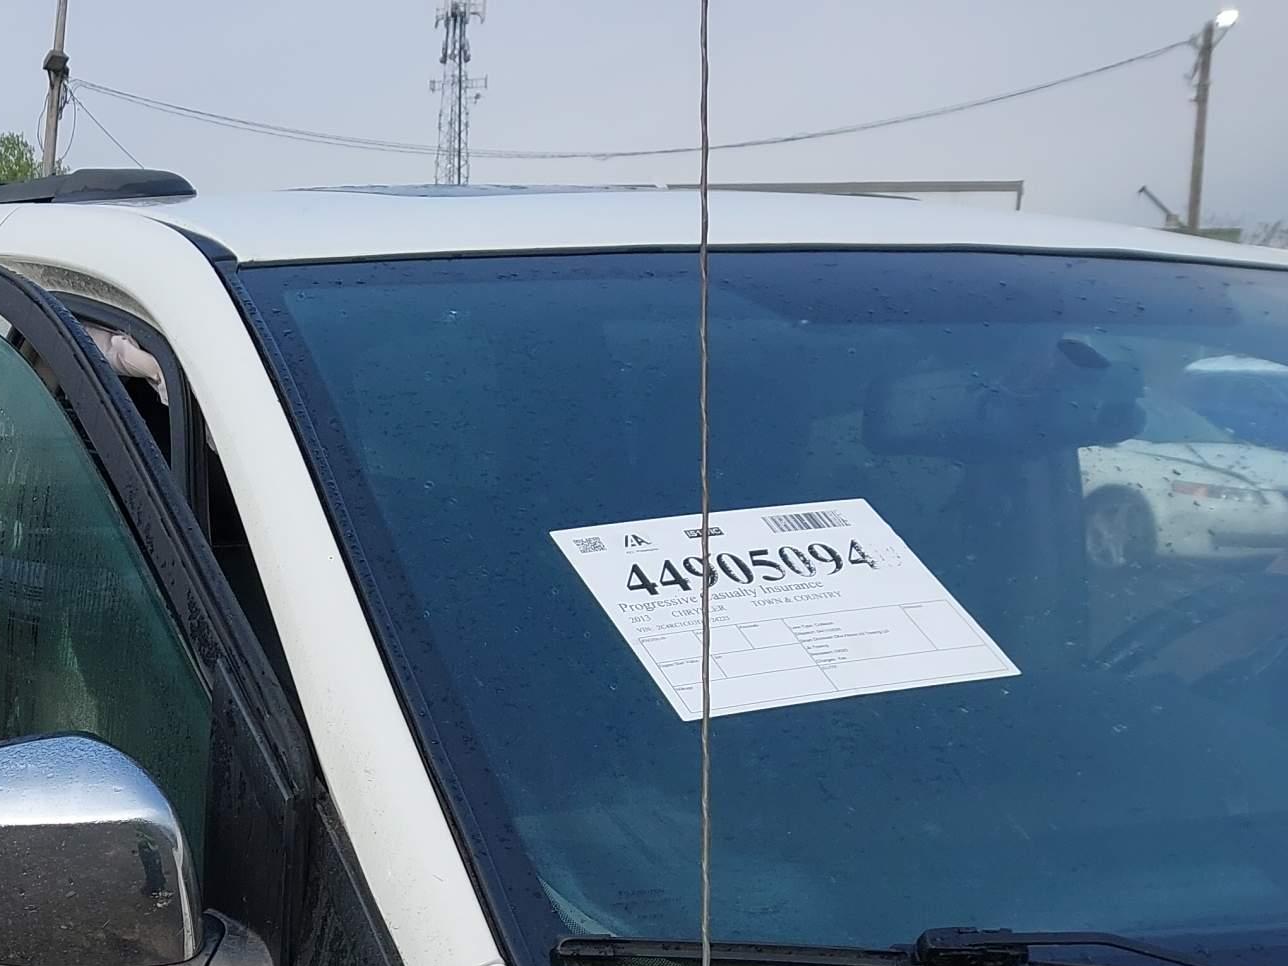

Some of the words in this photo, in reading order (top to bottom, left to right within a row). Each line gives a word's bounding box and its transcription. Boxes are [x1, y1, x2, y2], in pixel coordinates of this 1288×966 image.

[626, 539, 880, 596] 44905094
[618, 594, 698, 613] Progressive
[700, 585, 758, 602] asualty
[761, 580, 824, 596] Insurance
[628, 614, 652, 624] 2013
[671, 604, 728, 618] CHRYER
[752, 597, 783, 608] TOWN
[784, 595, 793, 604] &
[794, 591, 842, 602] COUNTRY
